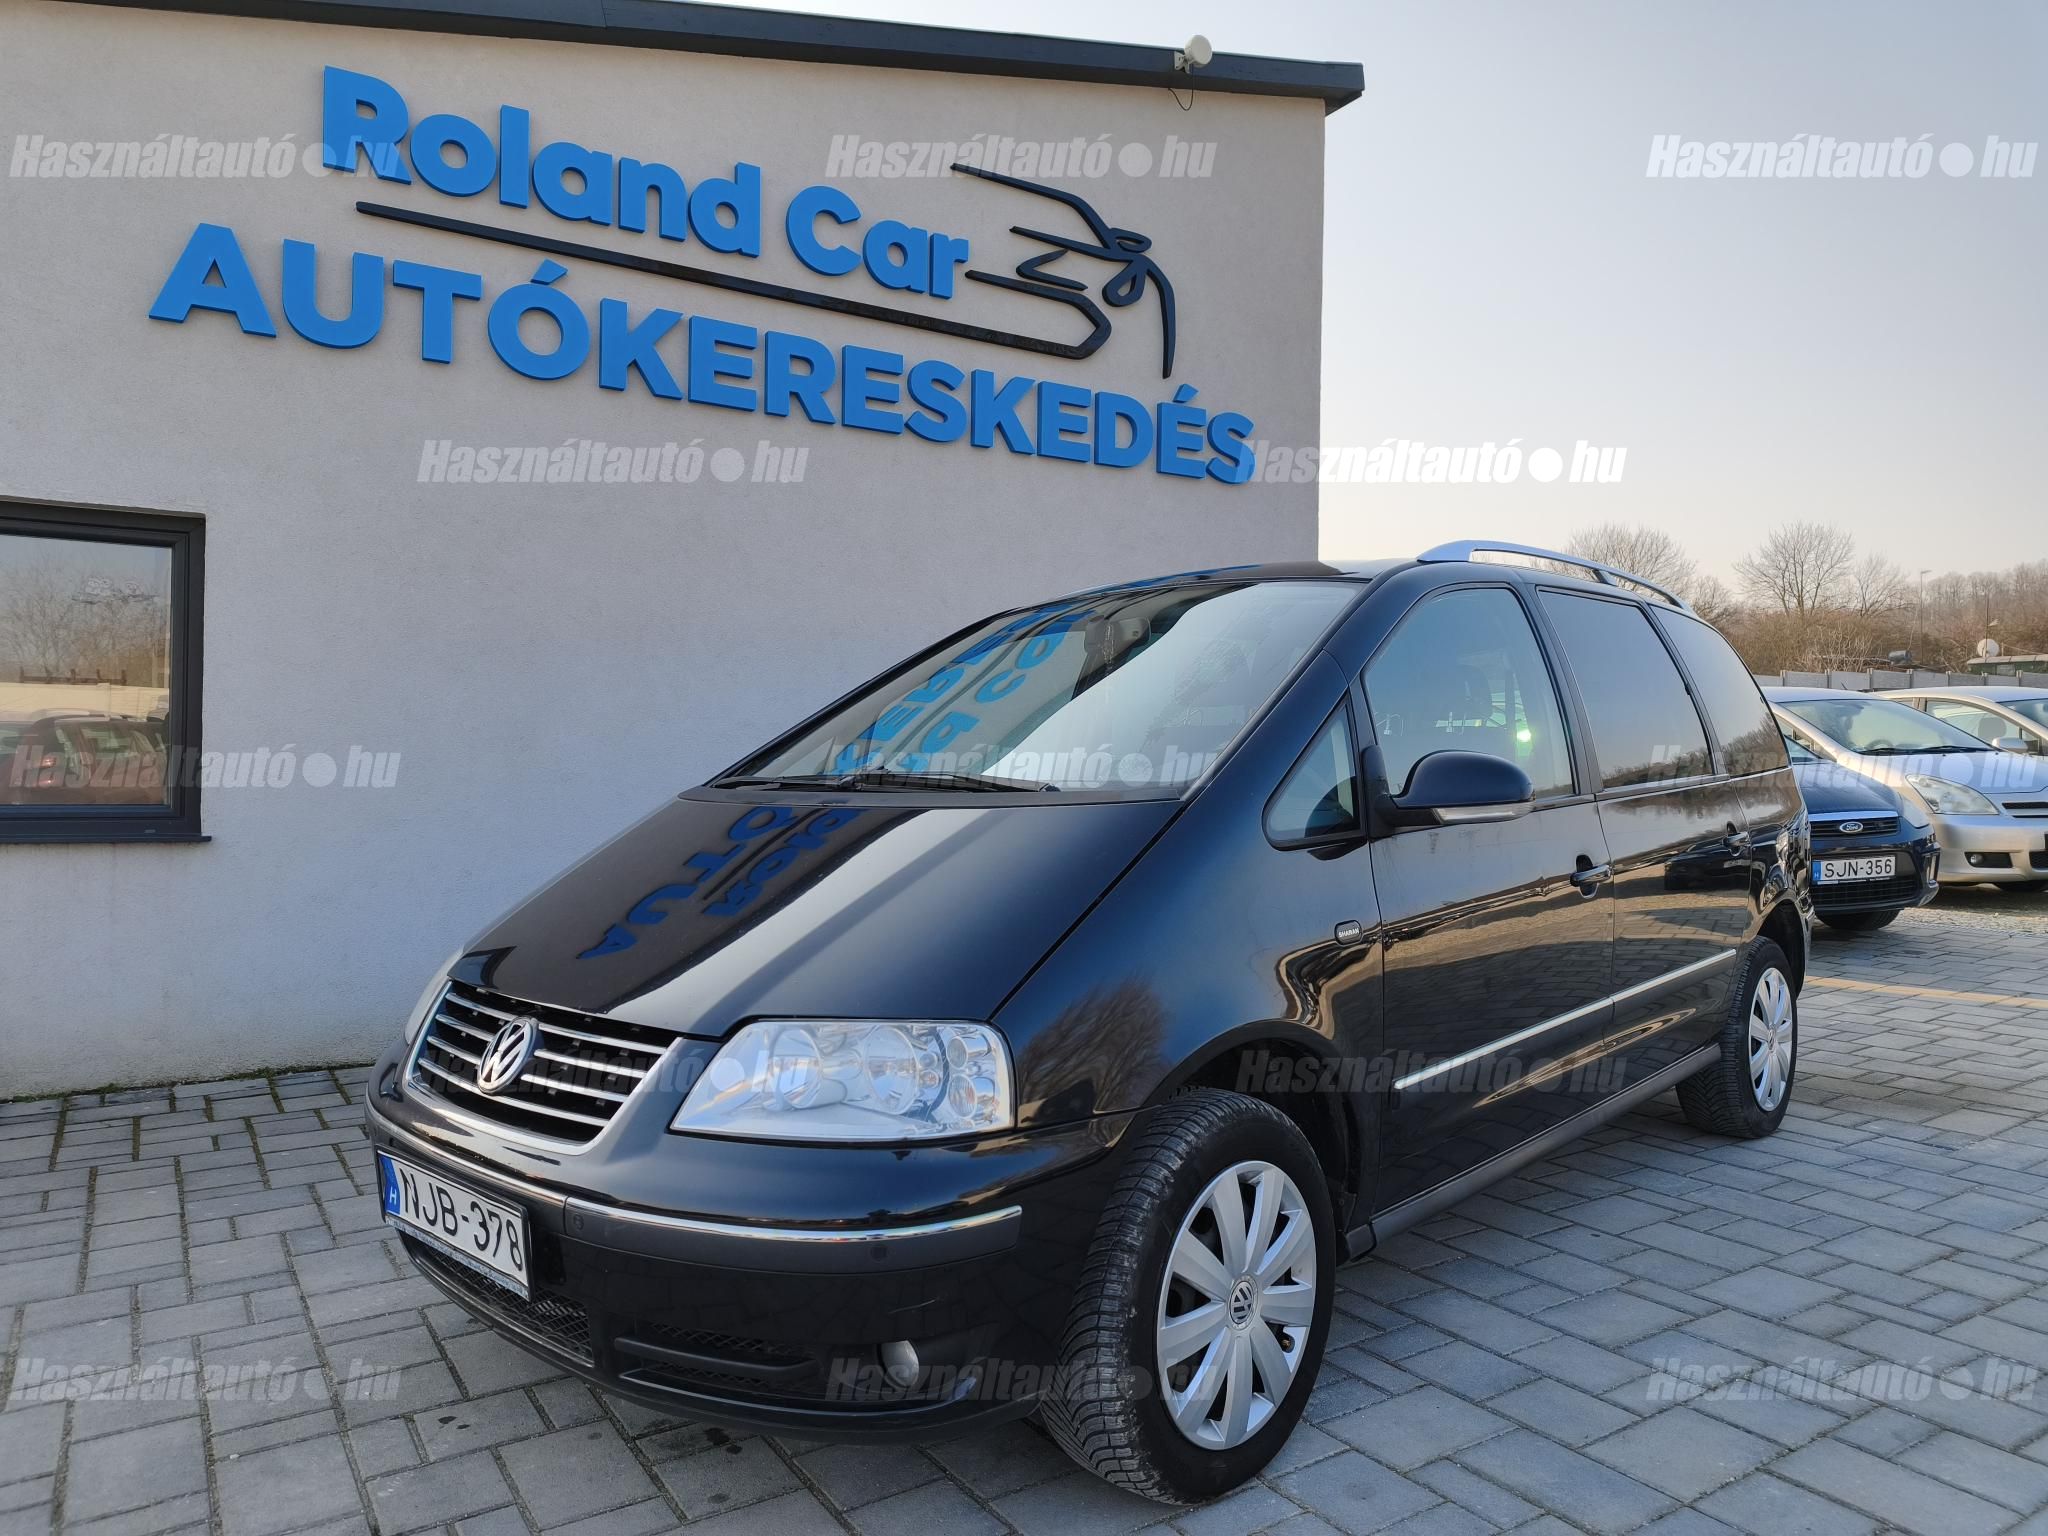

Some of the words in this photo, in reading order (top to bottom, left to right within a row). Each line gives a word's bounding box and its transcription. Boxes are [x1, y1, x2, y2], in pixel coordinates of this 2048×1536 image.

[322, 65, 761, 258] Roland
[785, 185, 969, 299] Car
[149, 222, 1255, 485] AUTÓKERESKEDÉS
[1824, 858, 1892, 878] SJN-356
[1338, 928, 1360, 938] SHARAN
[389, 1186, 397, 1205] H
[399, 1167, 523, 1272] NJB-378
